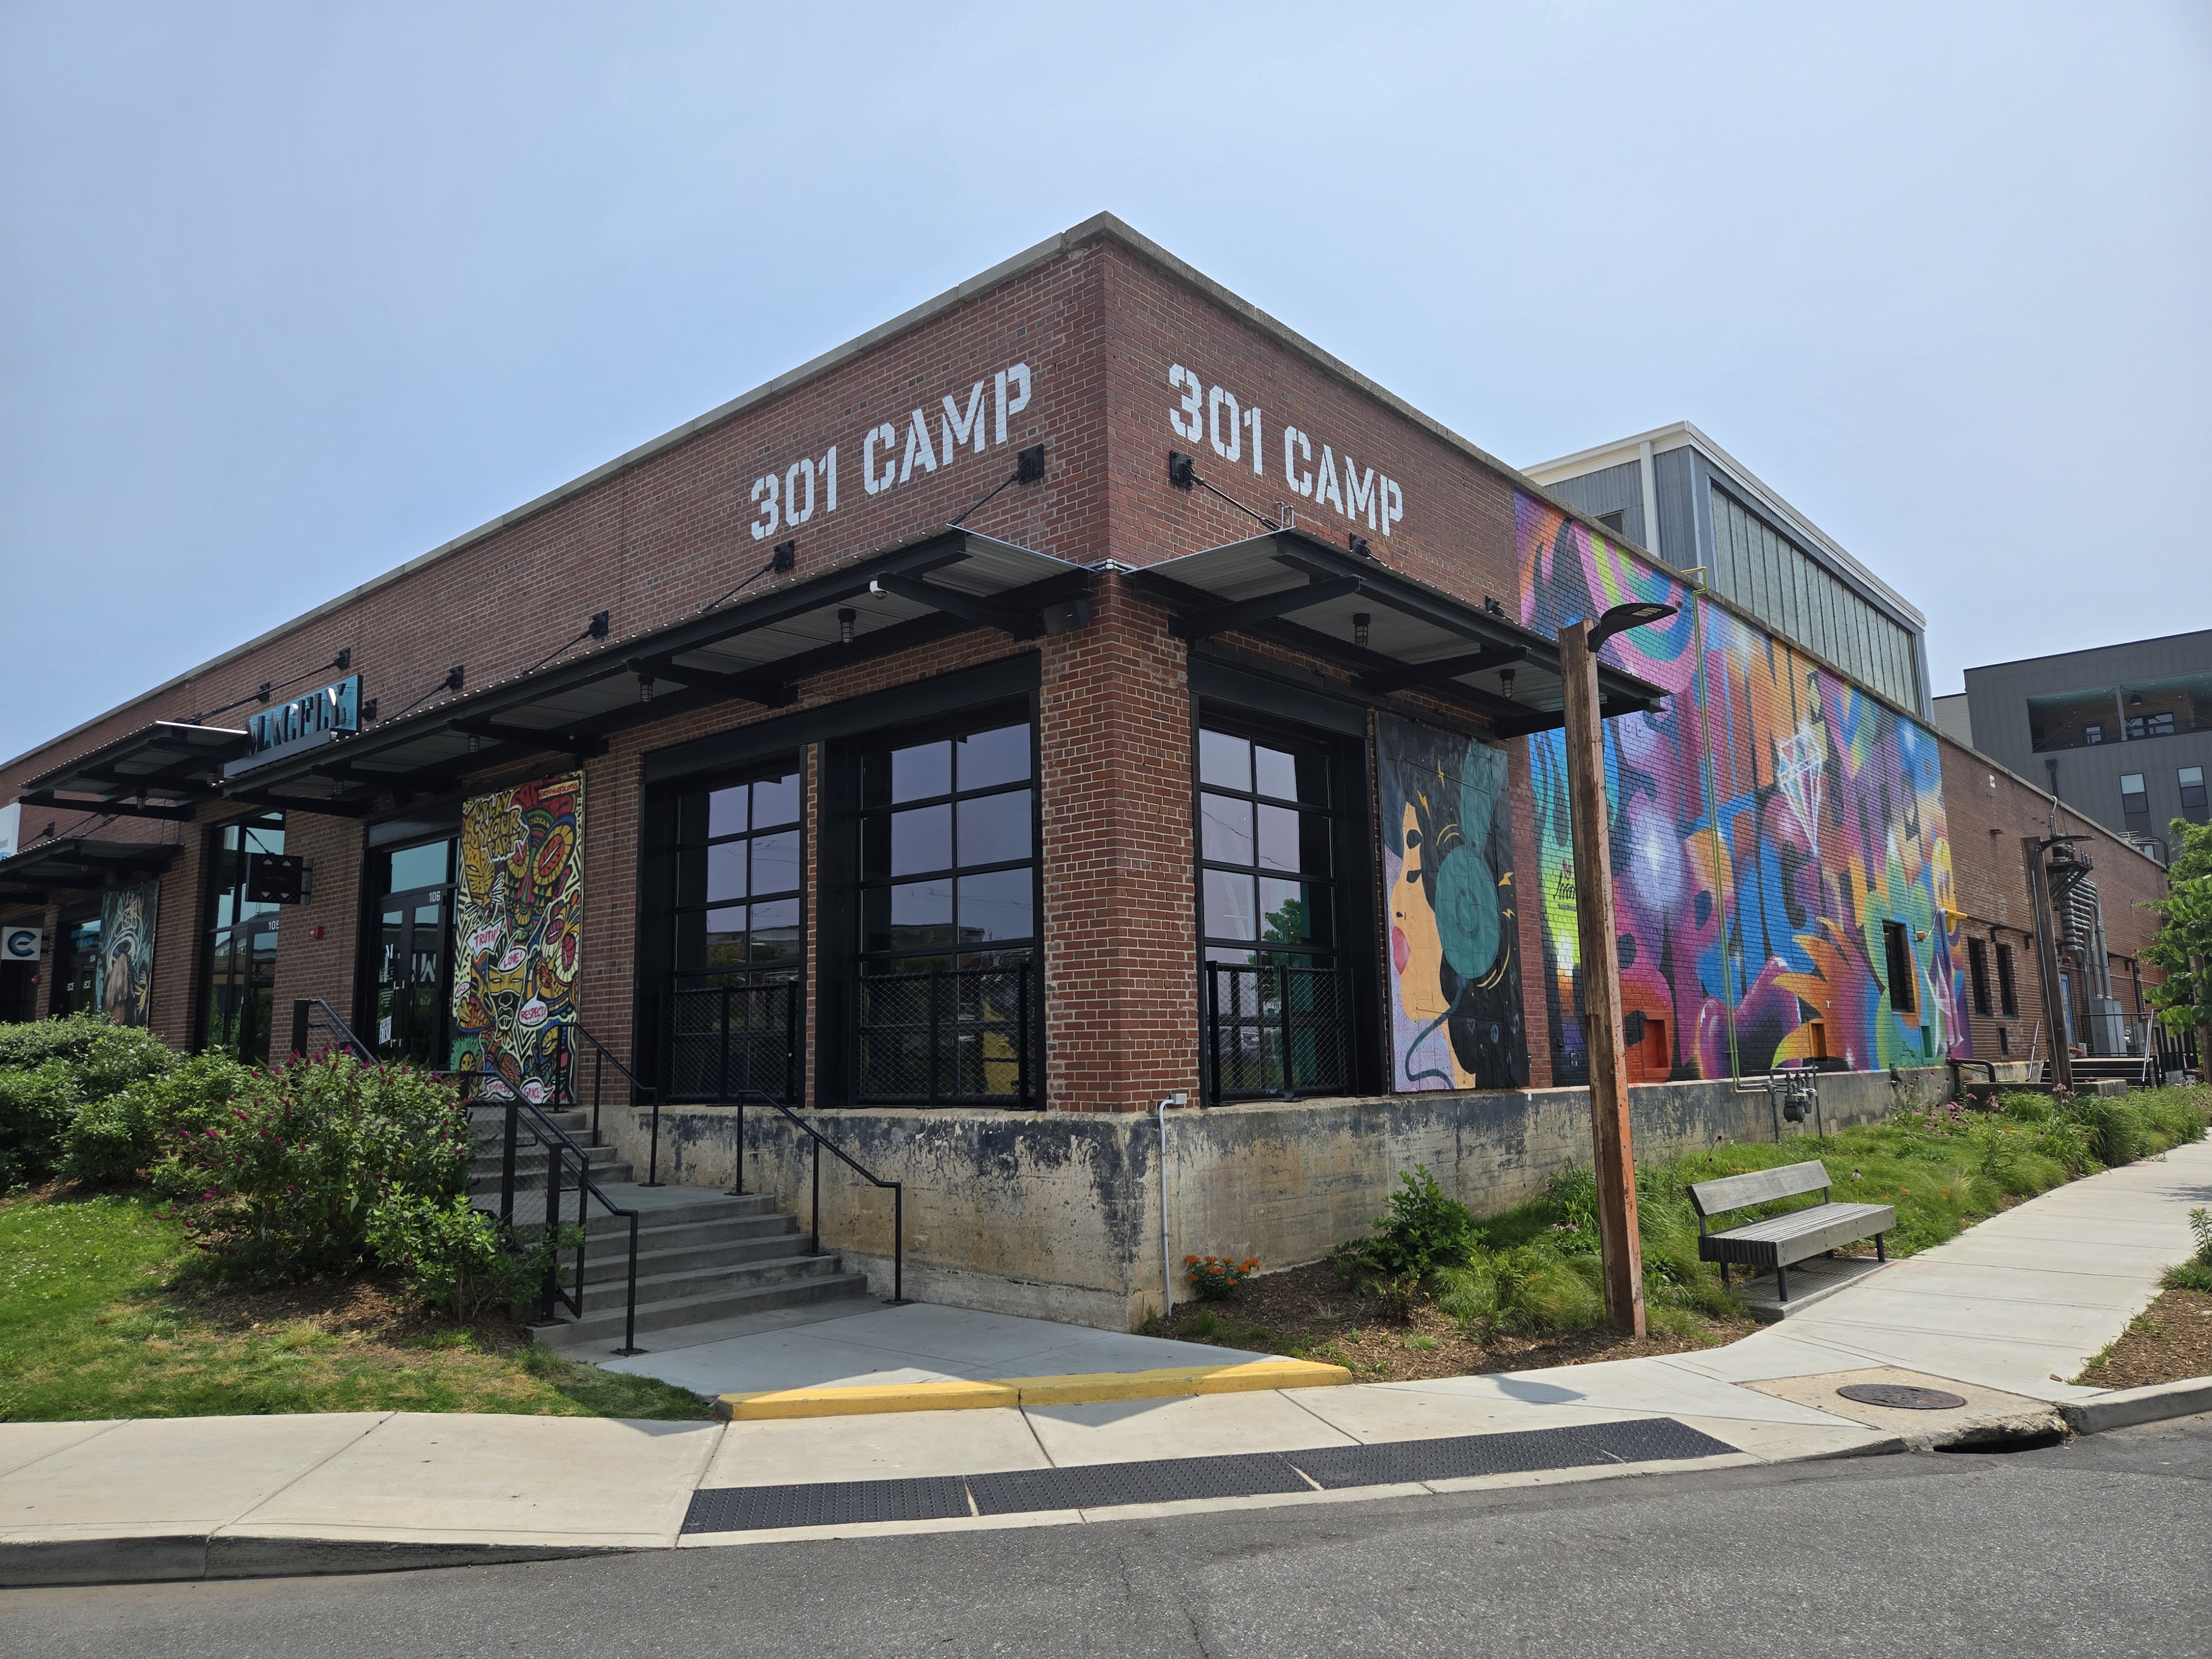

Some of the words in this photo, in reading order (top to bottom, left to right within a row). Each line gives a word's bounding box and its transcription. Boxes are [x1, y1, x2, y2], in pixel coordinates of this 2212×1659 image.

[750, 445, 837, 540] 301
[864, 362, 1032, 495] CAMP
[1168, 363, 1263, 475] 301
[1284, 426, 1404, 536] CAMP
[480, 809, 519, 846] YOUR
[429, 890, 441, 902] 106
[474, 926, 499, 948] TRUTH!
[503, 951, 523, 969] LOVE!
[521, 1006, 546, 1020] RESPECT!
[524, 1087, 542, 1100] GRACE!
